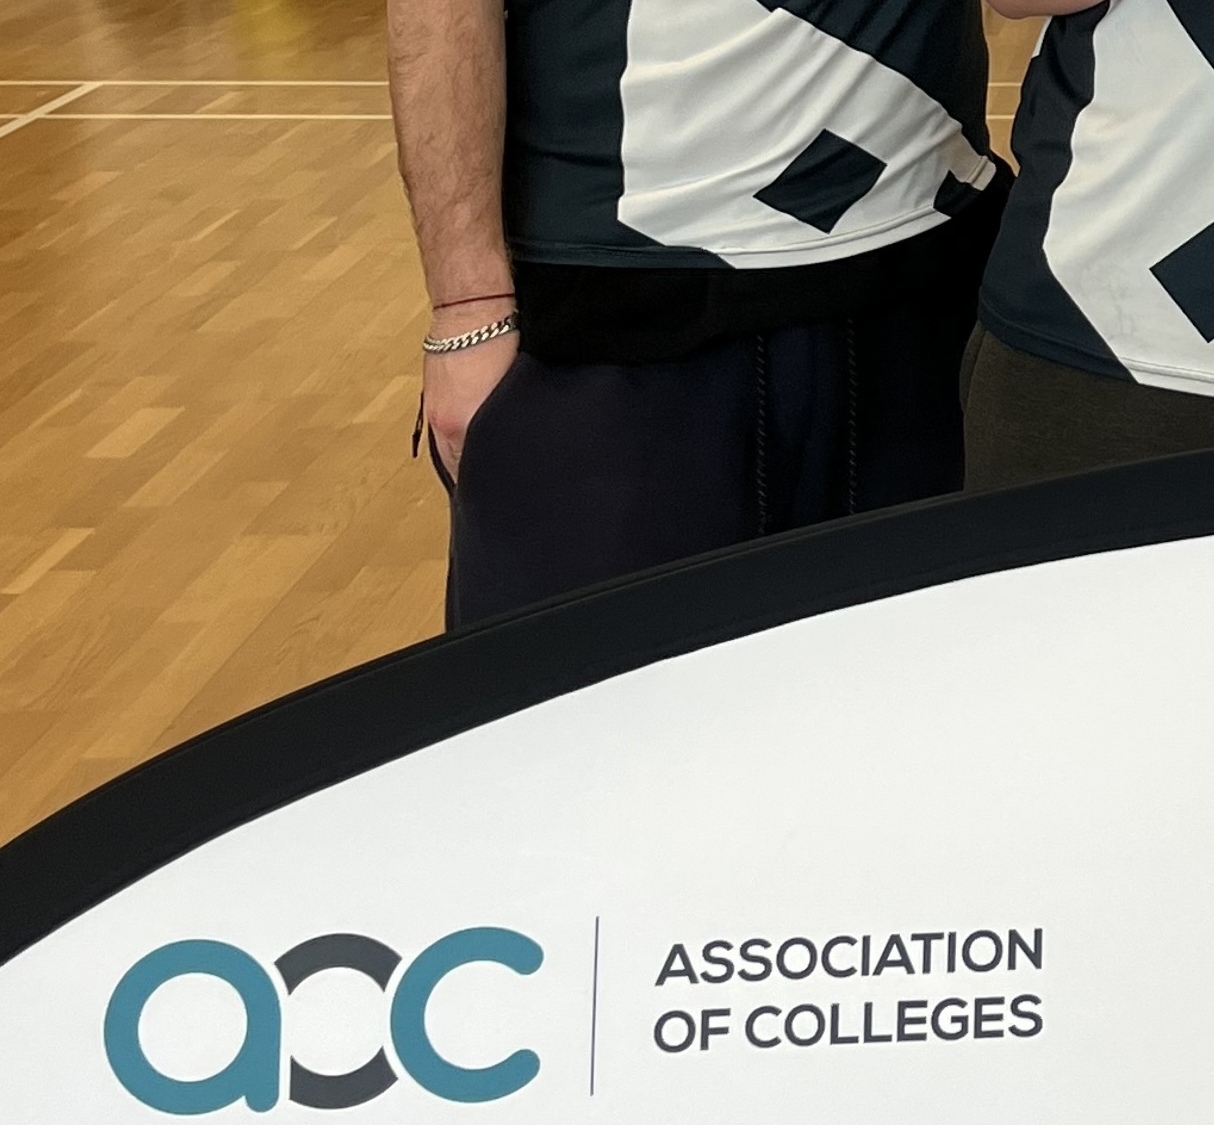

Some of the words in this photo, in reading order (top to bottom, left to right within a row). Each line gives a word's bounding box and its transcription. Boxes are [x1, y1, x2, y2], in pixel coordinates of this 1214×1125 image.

[654, 928, 1043, 987] ASSOCIATION
[653, 1008, 731, 1053] OF
[744, 993, 1043, 1049] COLLEGES
